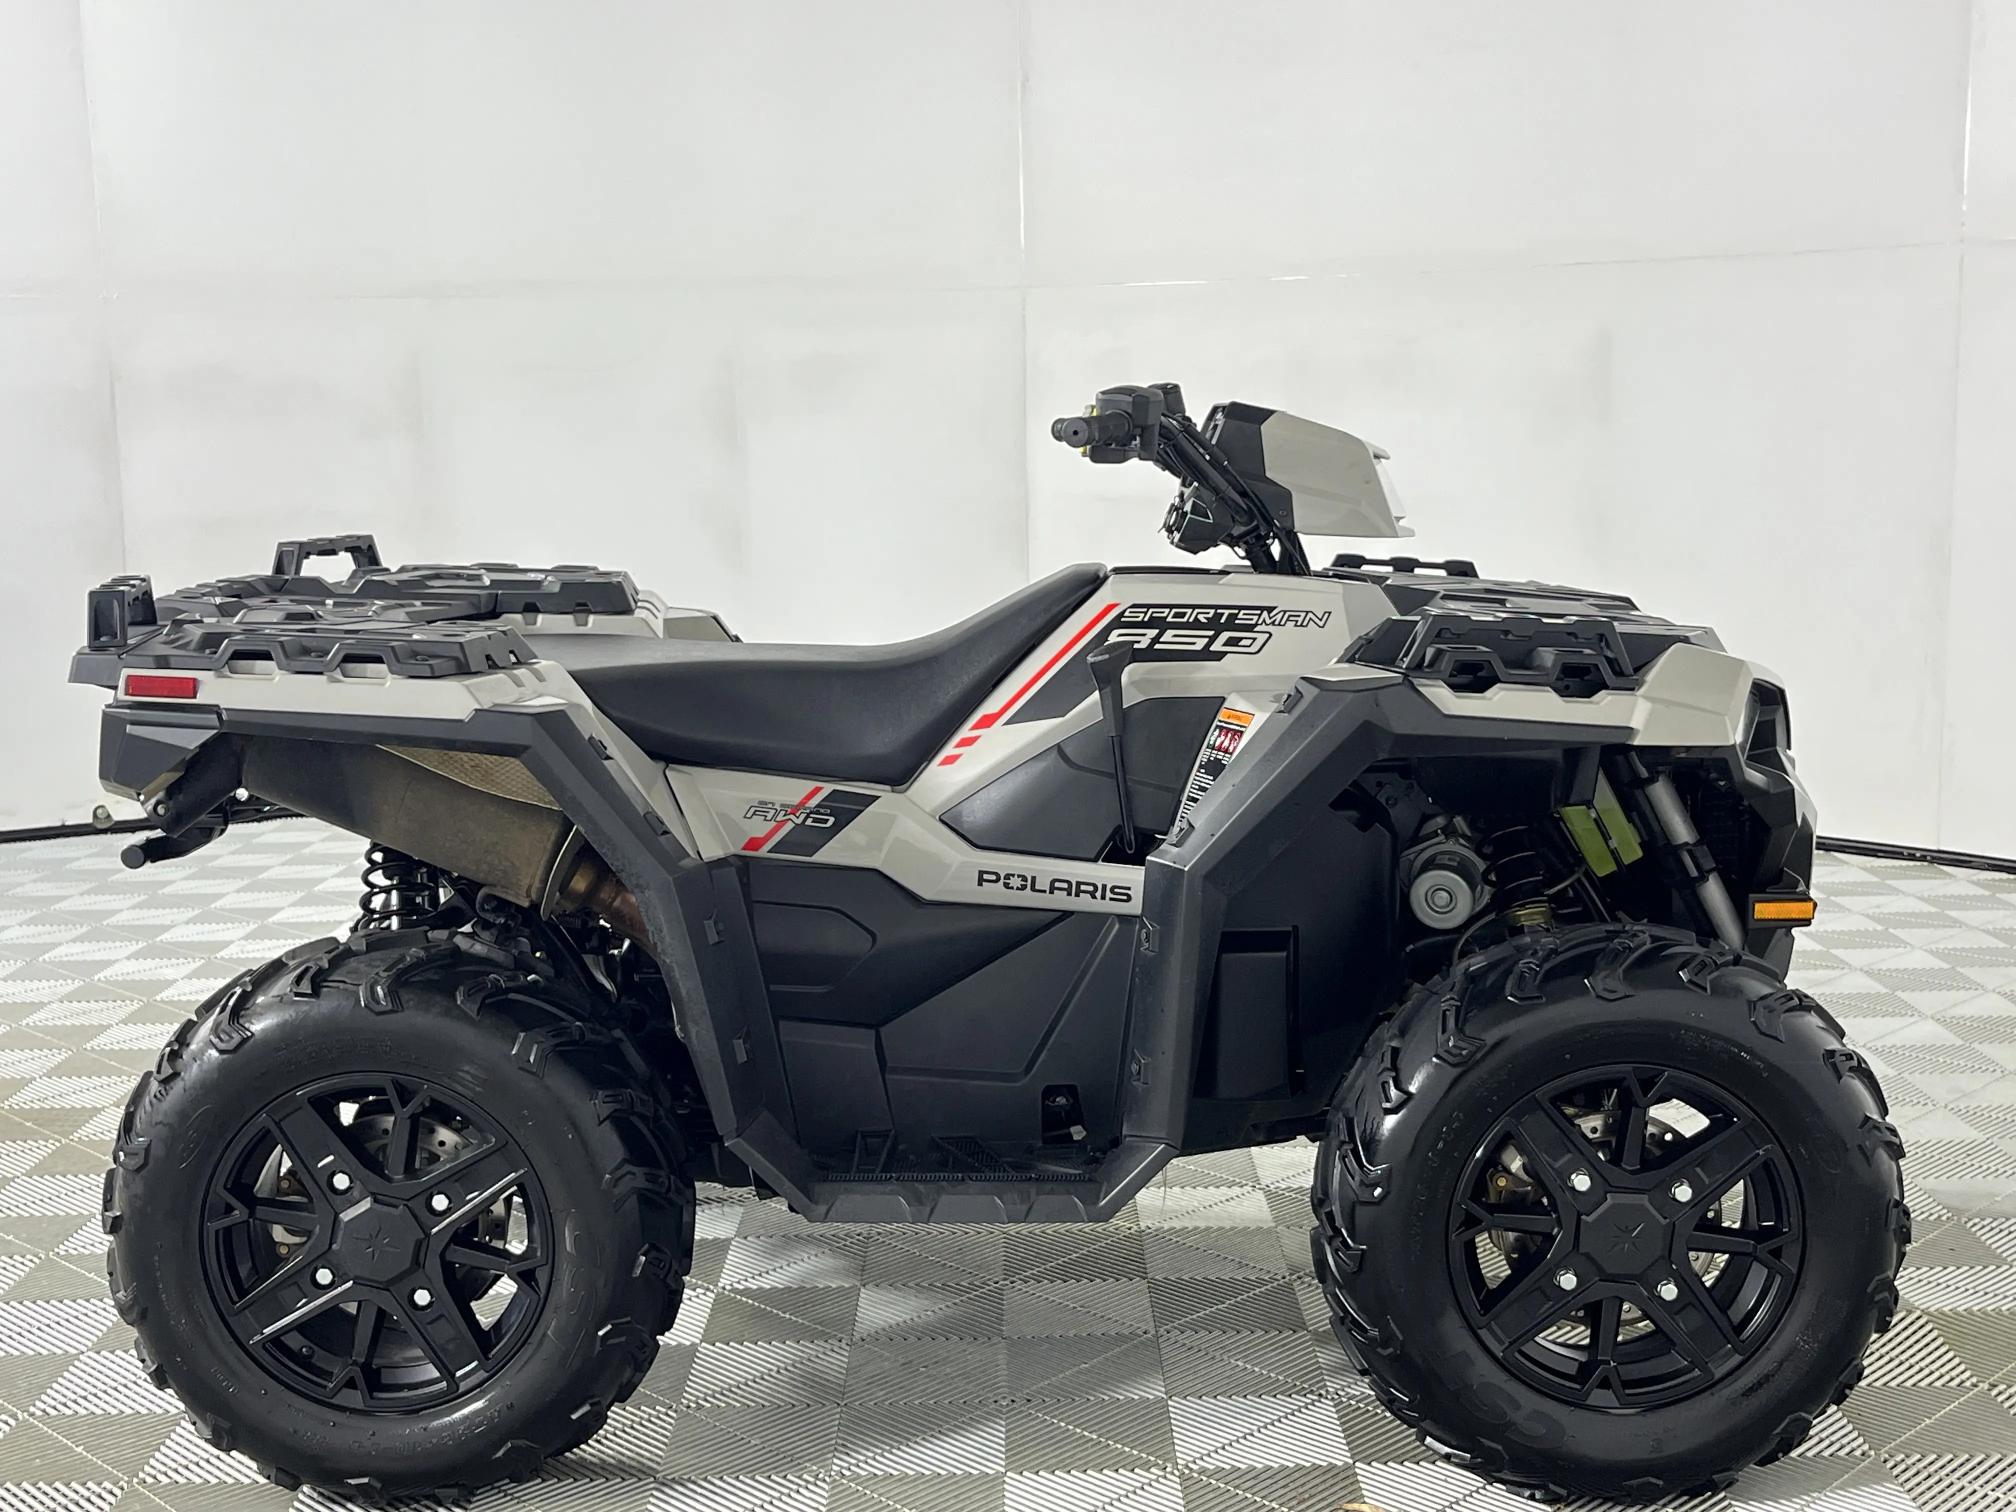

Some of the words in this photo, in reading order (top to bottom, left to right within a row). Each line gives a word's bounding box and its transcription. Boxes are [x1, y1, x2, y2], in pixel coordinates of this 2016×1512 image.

[1120, 607, 1332, 628] SPORTSMAN
[1104, 628, 1273, 655] 850
[744, 805, 836, 828] AWD
[977, 869, 1133, 903] POLARIS
